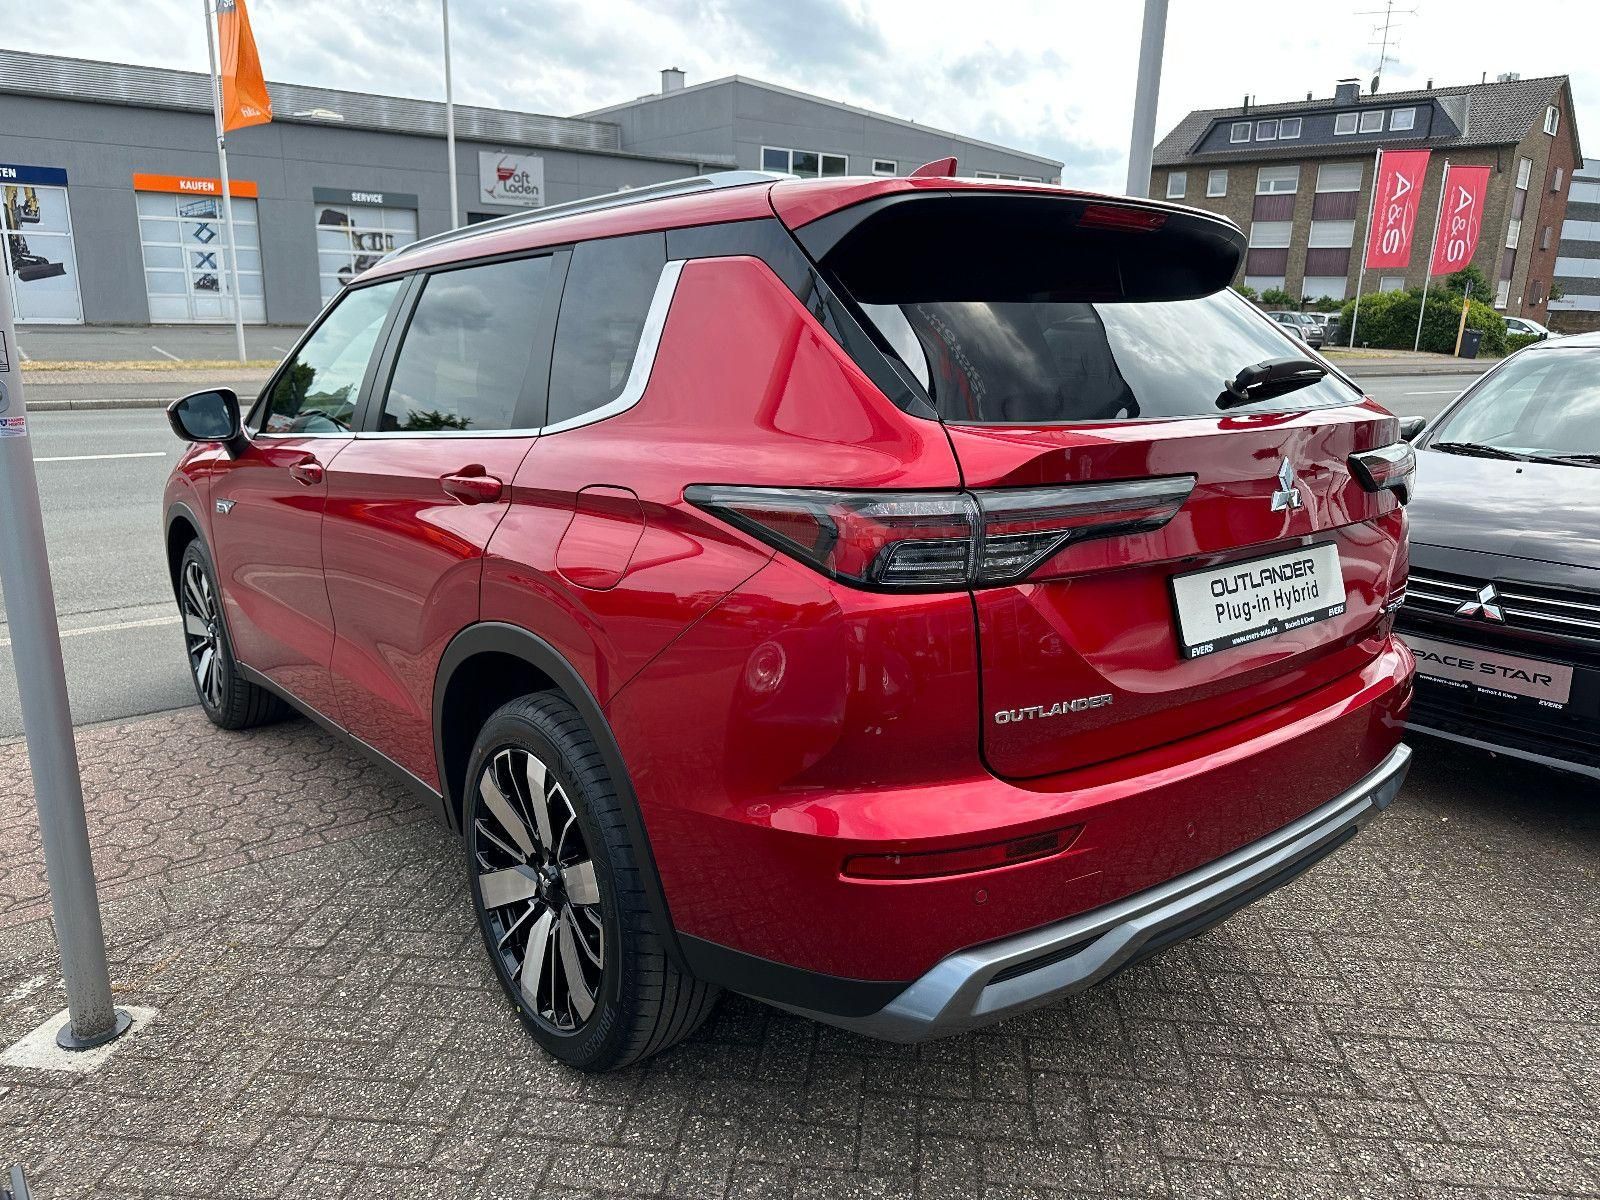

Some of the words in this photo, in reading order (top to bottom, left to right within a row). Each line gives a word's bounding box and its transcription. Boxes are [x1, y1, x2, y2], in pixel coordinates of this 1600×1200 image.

[180, 181, 215, 192] KAUFEN
[351, 192, 383, 204] SERVICE
[1382, 171, 1411, 254] A&S
[1447, 185, 1473, 262] A&S
[1210, 558, 1315, 598] OUTLANDER
[1215, 593, 1271, 623] Plug-in
[1273, 580, 1320, 610] Hybrid
[1328, 606, 1344, 617] EVERS
[1231, 626, 1278, 645] www.evers-auto.de
[1191, 643, 1214, 658] EVERS
[1410, 649, 1475, 671] PACE
[1479, 662, 1553, 688] STAR
[994, 693, 1114, 724] OUTLANDER
[1538, 699, 1563, 710] EVERS
